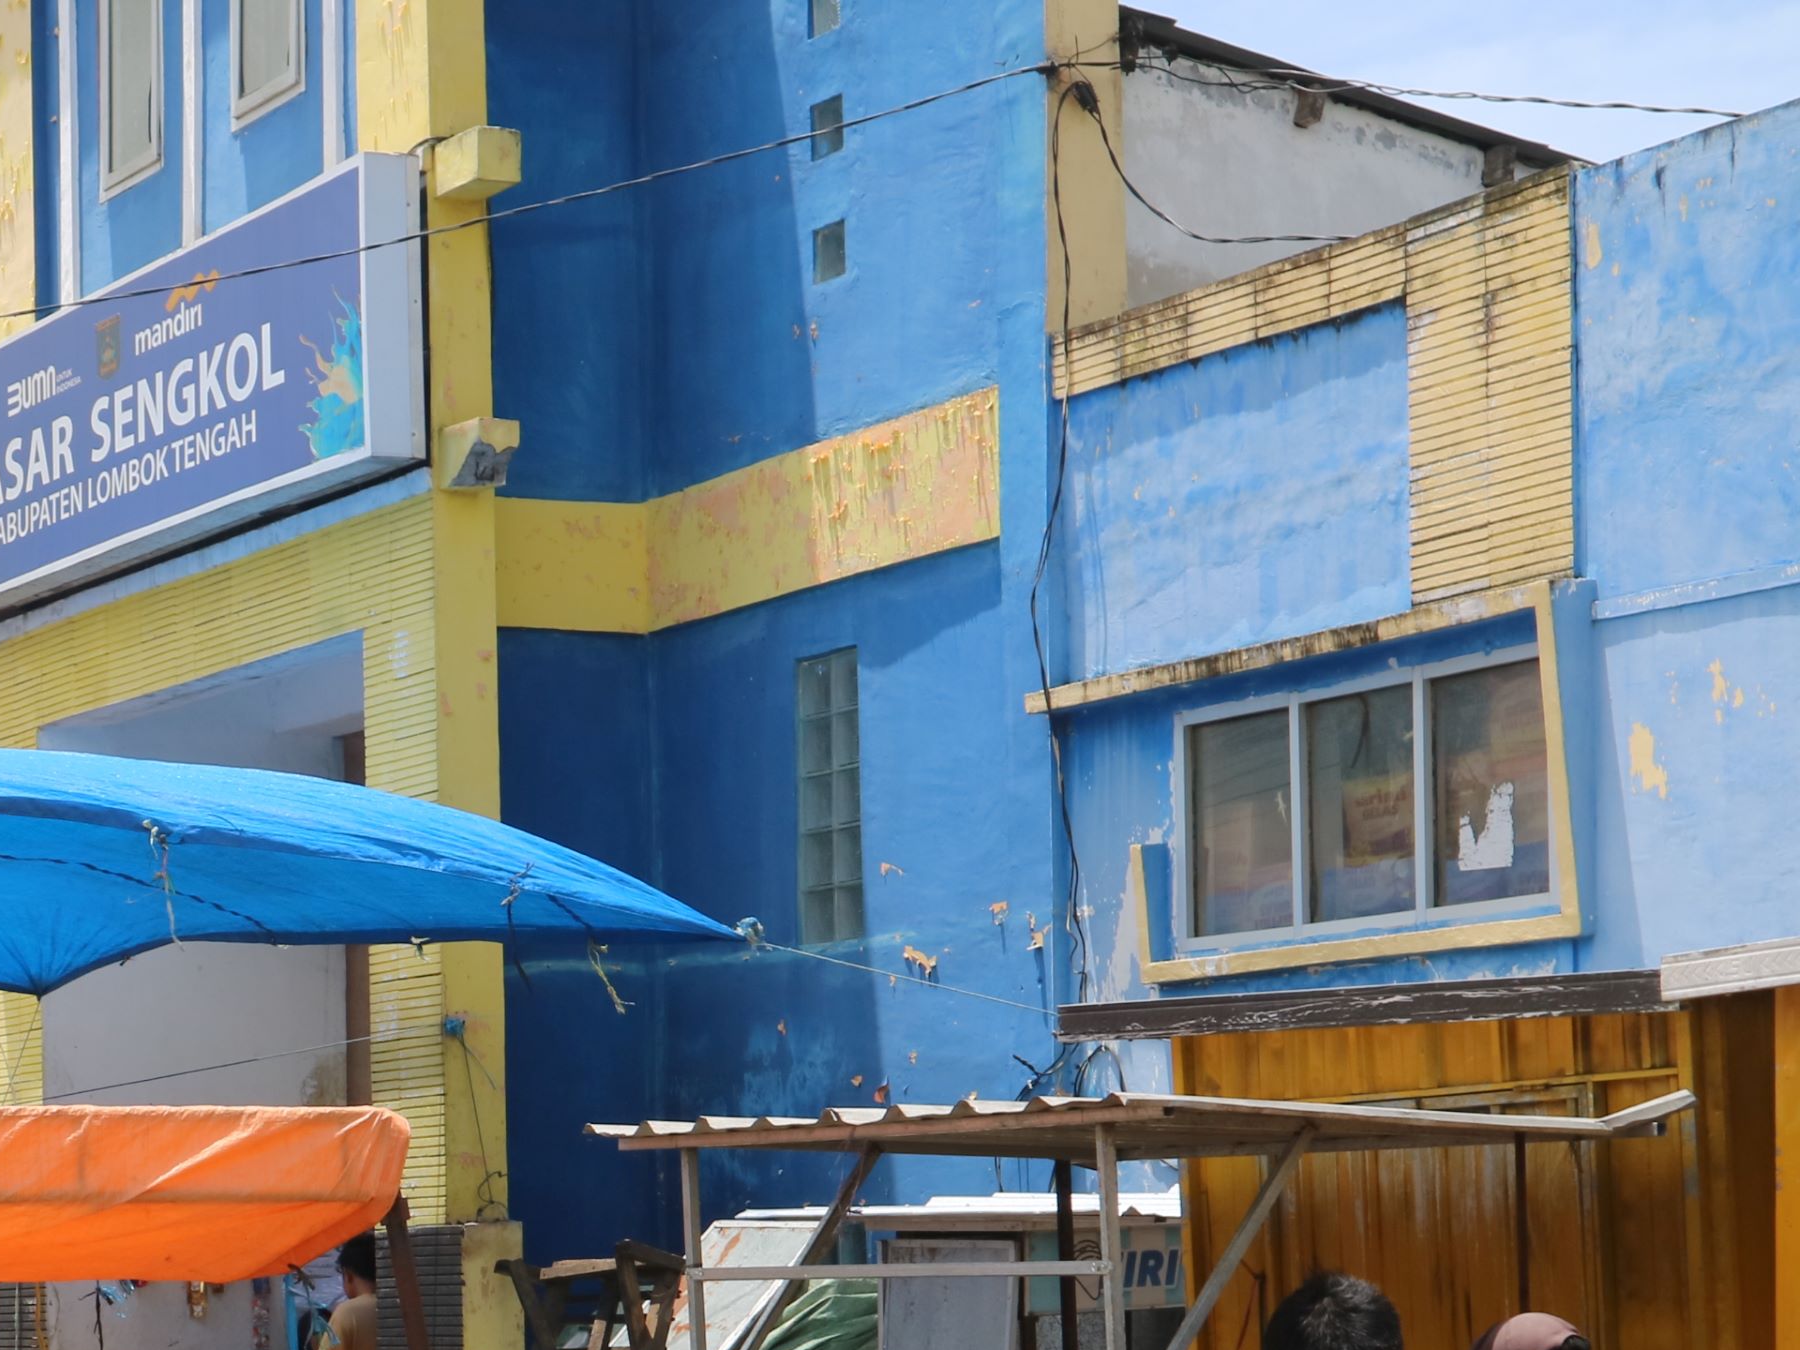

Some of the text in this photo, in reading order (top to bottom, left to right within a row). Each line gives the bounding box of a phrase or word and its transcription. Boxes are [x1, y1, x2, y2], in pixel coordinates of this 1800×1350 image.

[135, 303, 202, 355] mandiri
[91, 322, 285, 463] SENGKOL
[88, 445, 168, 508] LOMBOK
[172, 409, 257, 473] TENGAH
